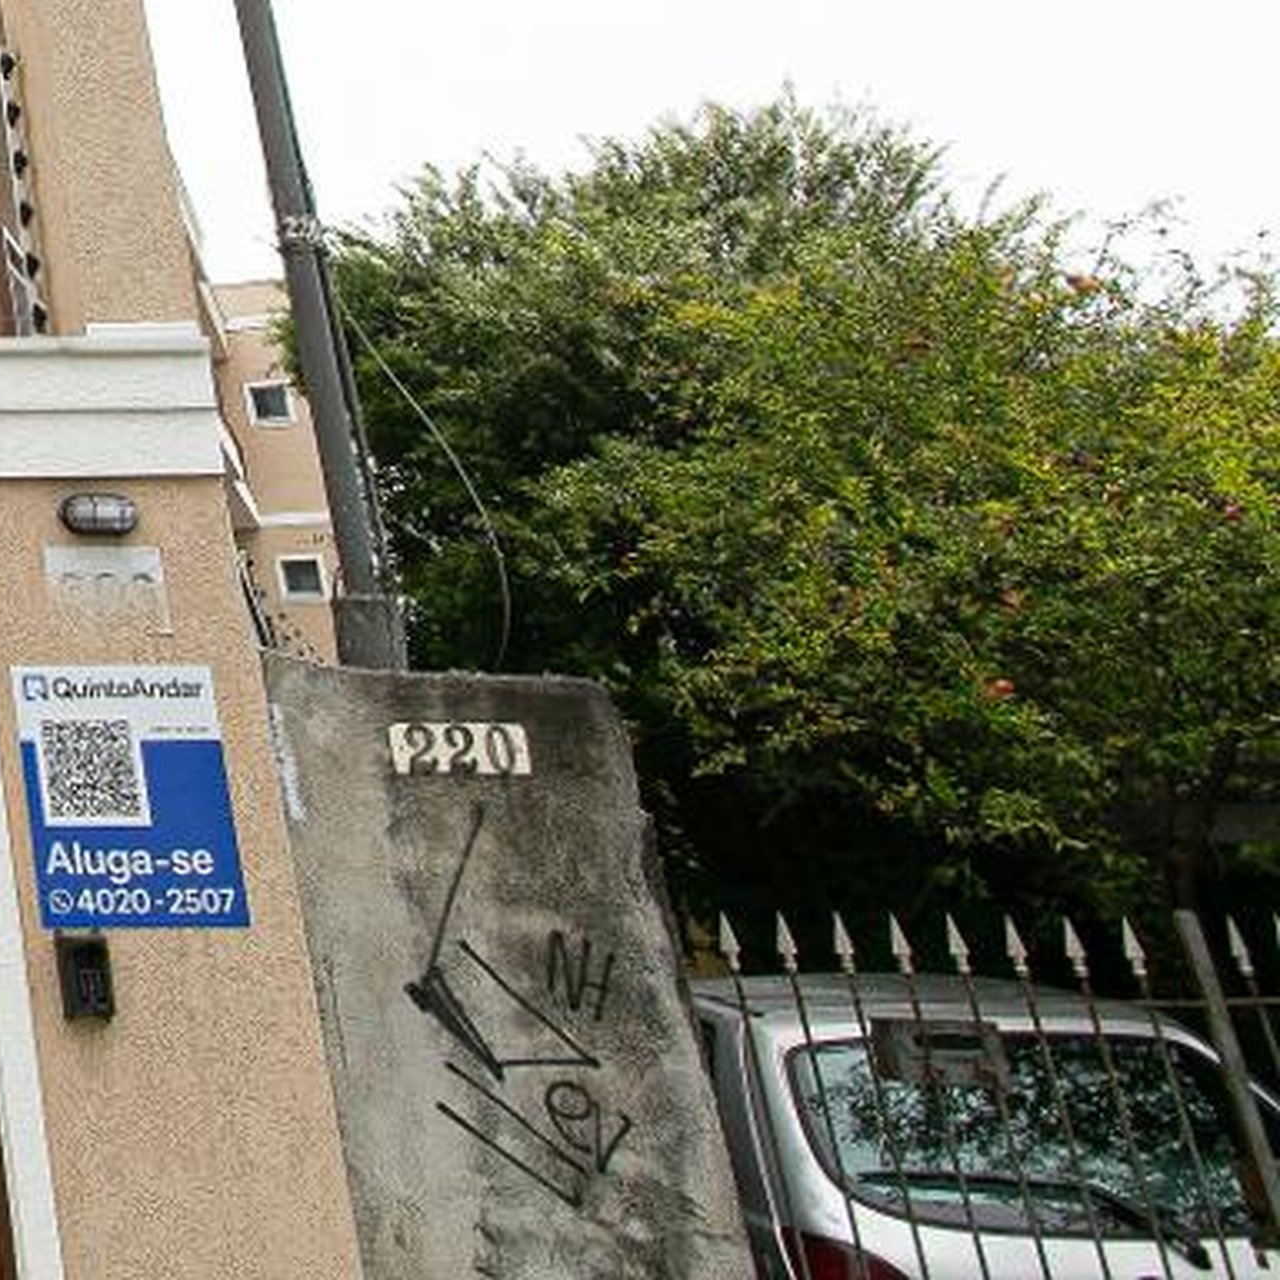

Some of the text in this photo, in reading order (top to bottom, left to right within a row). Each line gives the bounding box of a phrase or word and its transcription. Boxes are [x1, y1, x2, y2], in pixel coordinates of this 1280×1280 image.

[52, 677, 203, 701] QuintoAndar
[403, 723, 516, 776] 220
[46, 841, 215, 885] Aluga-se
